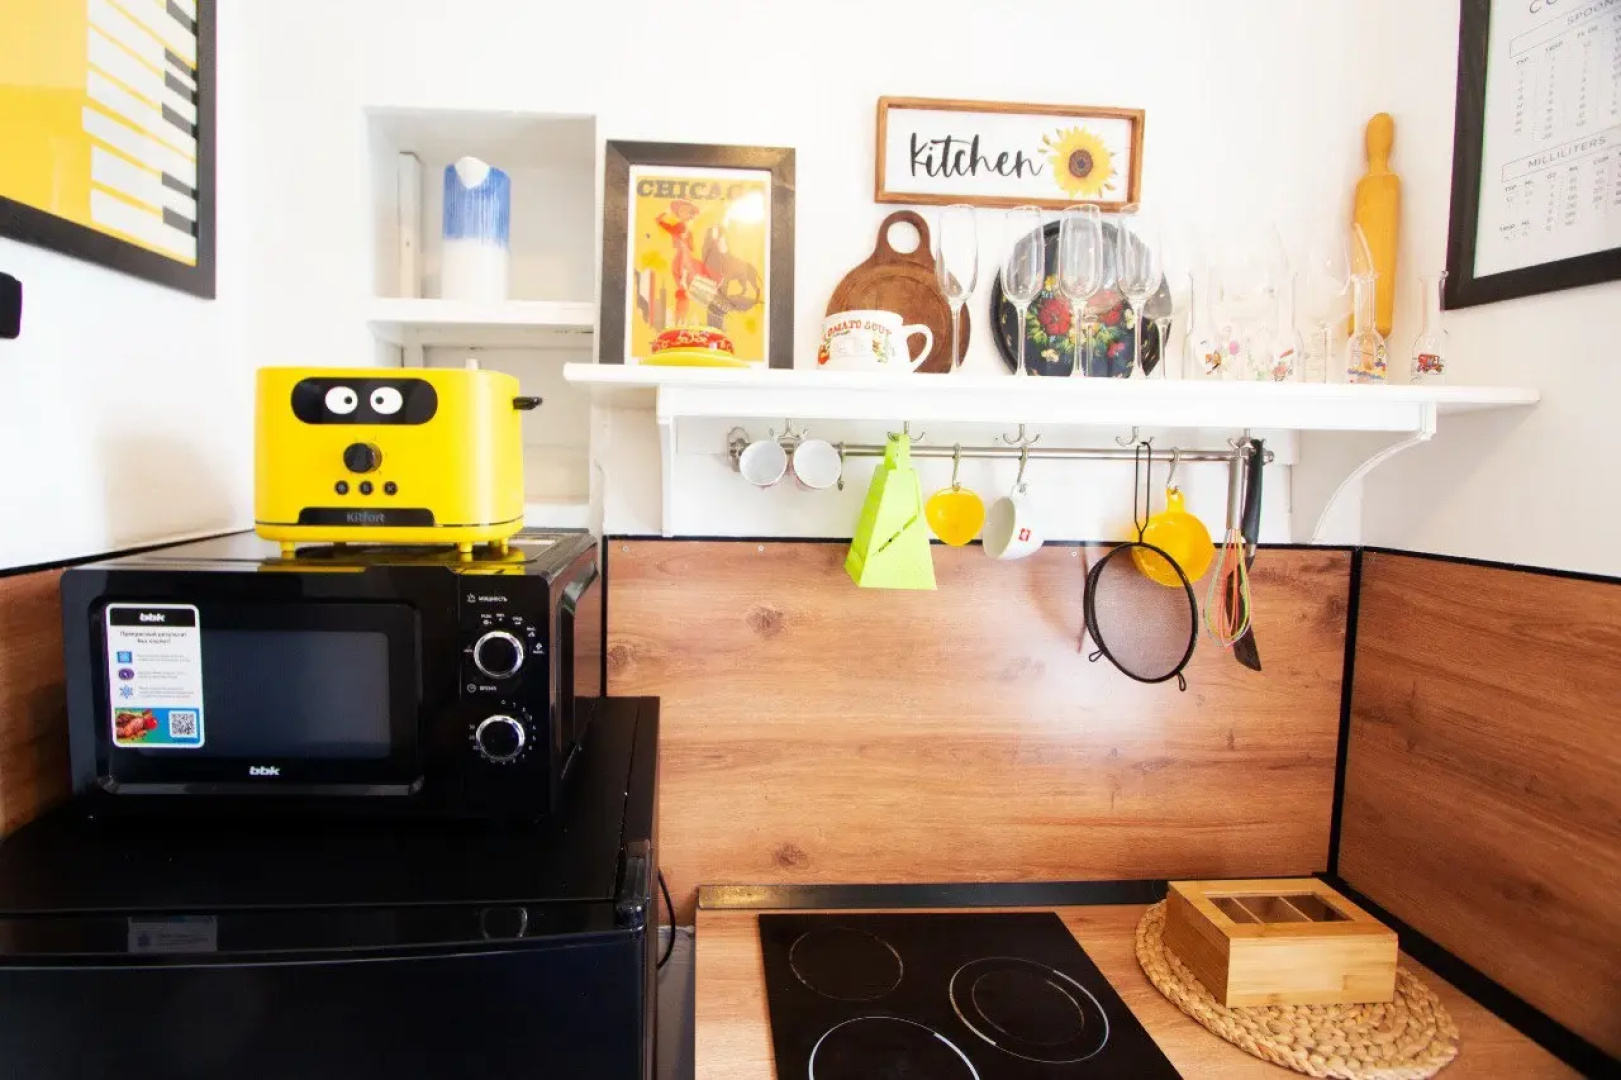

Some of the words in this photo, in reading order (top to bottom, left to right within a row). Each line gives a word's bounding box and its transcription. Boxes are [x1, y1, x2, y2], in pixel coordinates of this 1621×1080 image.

[1527, 136, 1607, 168] MILLILITERS
[138, 612, 166, 623] bbk
[249, 765, 281, 776] bbk
